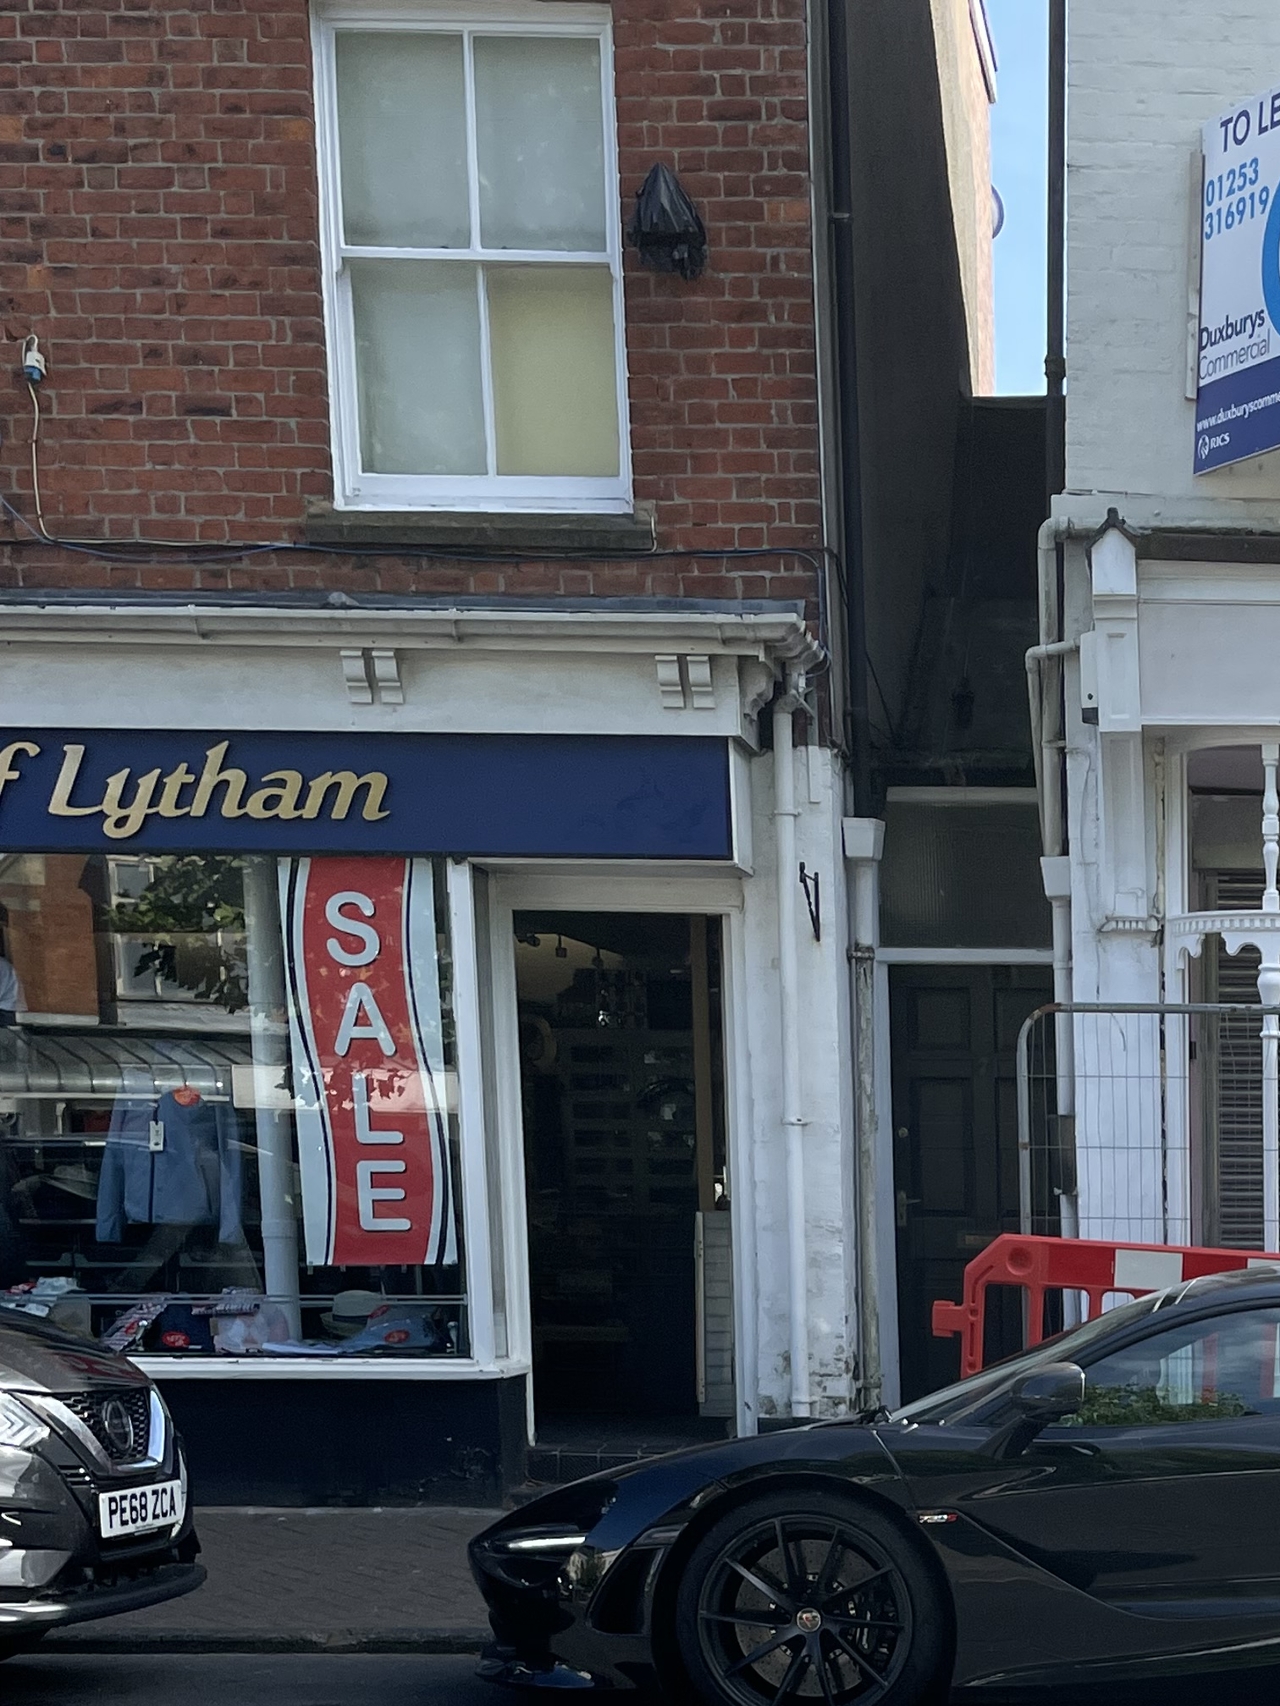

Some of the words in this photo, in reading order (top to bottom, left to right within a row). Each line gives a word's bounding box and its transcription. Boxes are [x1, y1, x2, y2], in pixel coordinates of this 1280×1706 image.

[1220, 109, 1251, 153] TO
[1205, 157, 1259, 207] 01253
[1204, 185, 1270, 241] 316919
[1199, 308, 1266, 353] Duxburys
[1199, 327, 1271, 380] Commercial
[1210, 432, 1230, 450] RICS
[48, 740, 390, 839] Lytham
[324, 891, 412, 1232] SALE
[108, 1491, 148, 1529] PE68
[151, 1486, 177, 1520] ZCA
